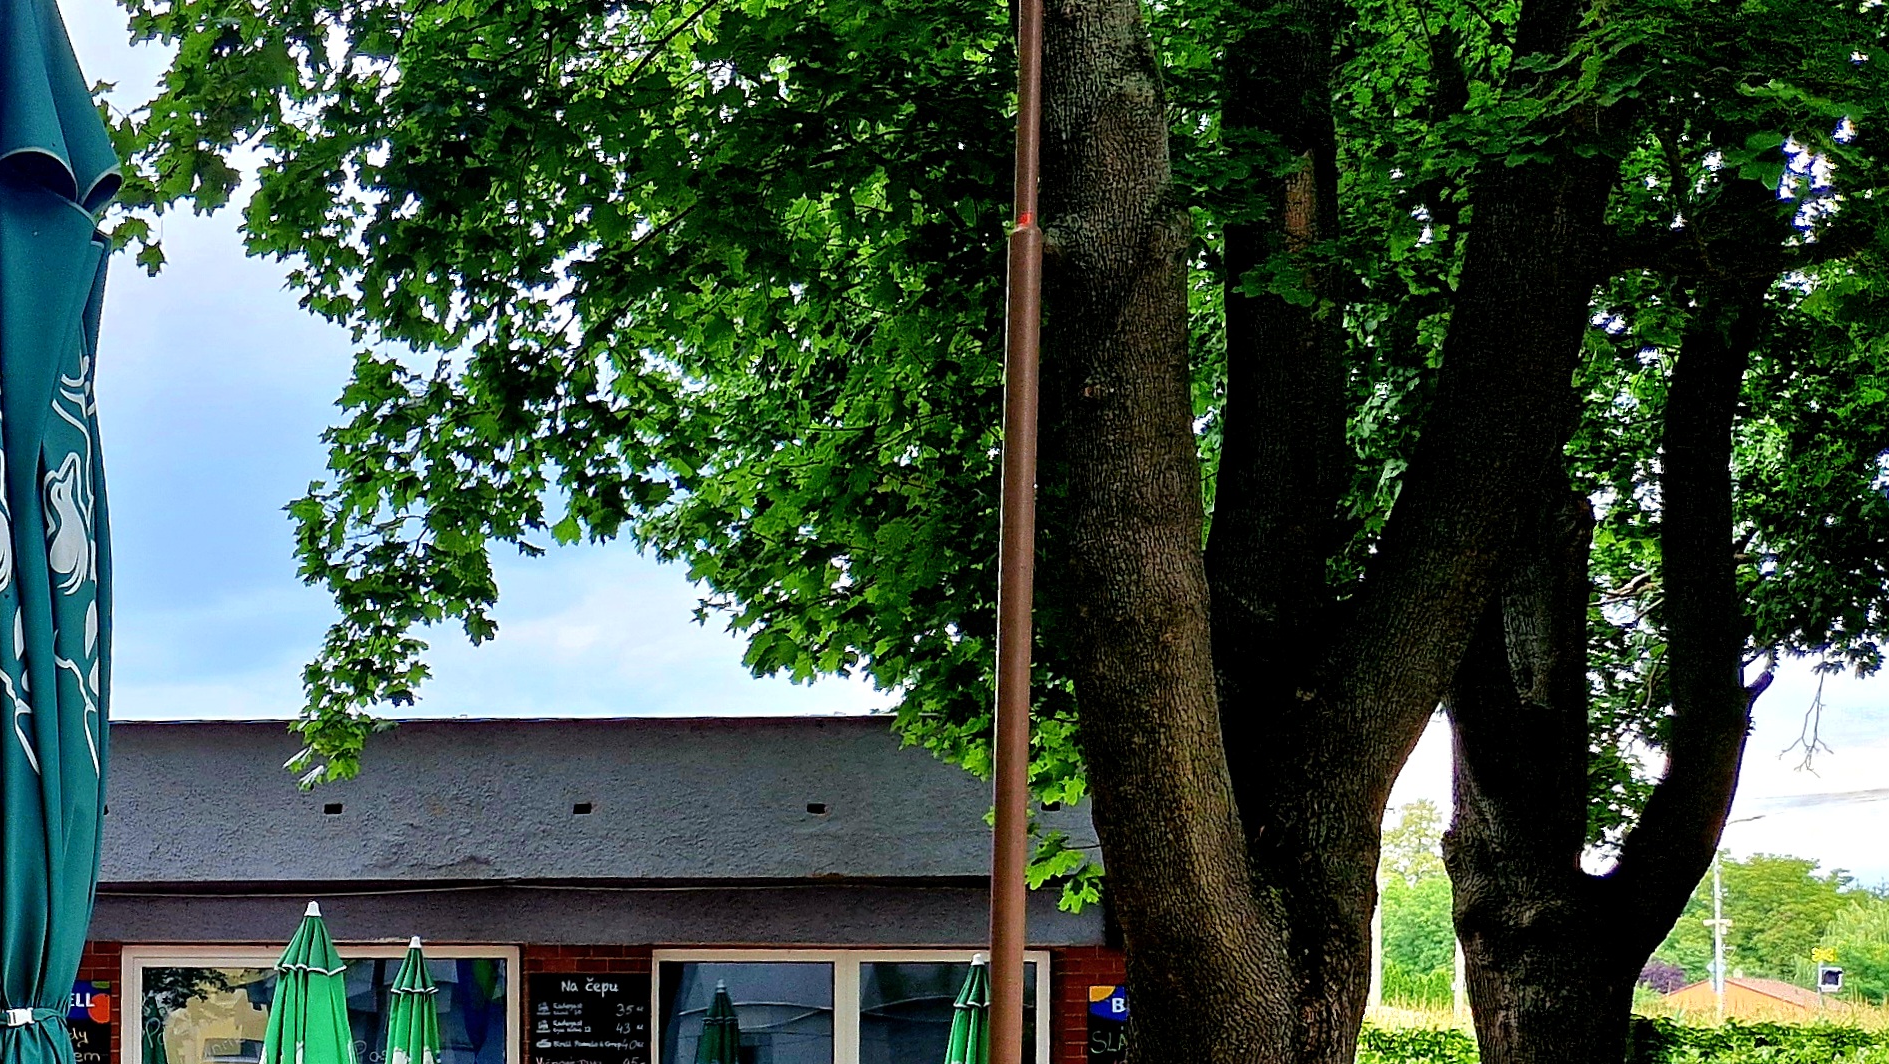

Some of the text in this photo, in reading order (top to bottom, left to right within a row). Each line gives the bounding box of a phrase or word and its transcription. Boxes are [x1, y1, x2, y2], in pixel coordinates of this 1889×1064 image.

[561, 977, 619, 998] Na čepu
[616, 1003, 635, 1017] 35
[616, 1022, 631, 1034] 43
